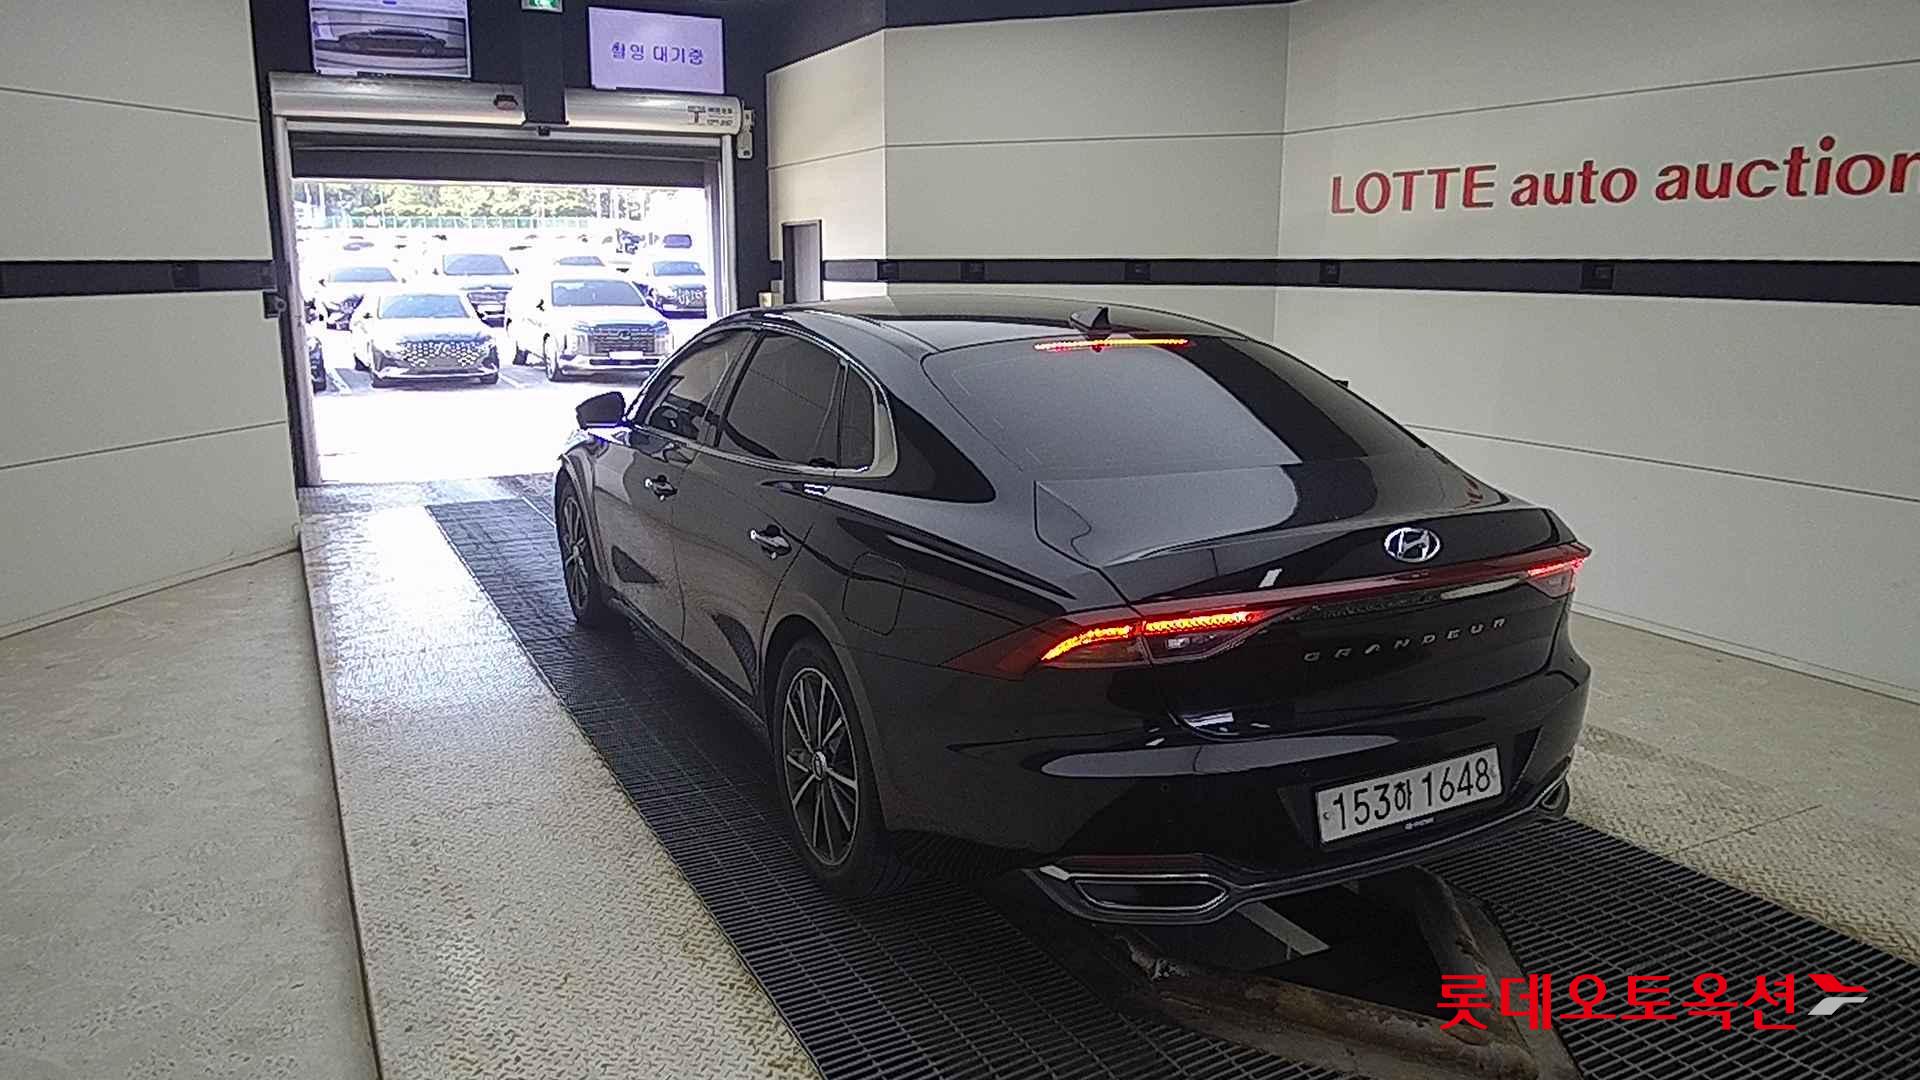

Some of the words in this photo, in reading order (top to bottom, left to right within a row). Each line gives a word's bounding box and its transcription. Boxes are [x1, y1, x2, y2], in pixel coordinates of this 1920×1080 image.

[1331, 164, 1498, 214] LOTTE
[1510, 160, 1638, 206] auto
[1304, 617, 1505, 662] GRANDEUR
[1333, 778, 1412, 831] 153하
[1422, 757, 1491, 807] 1648
